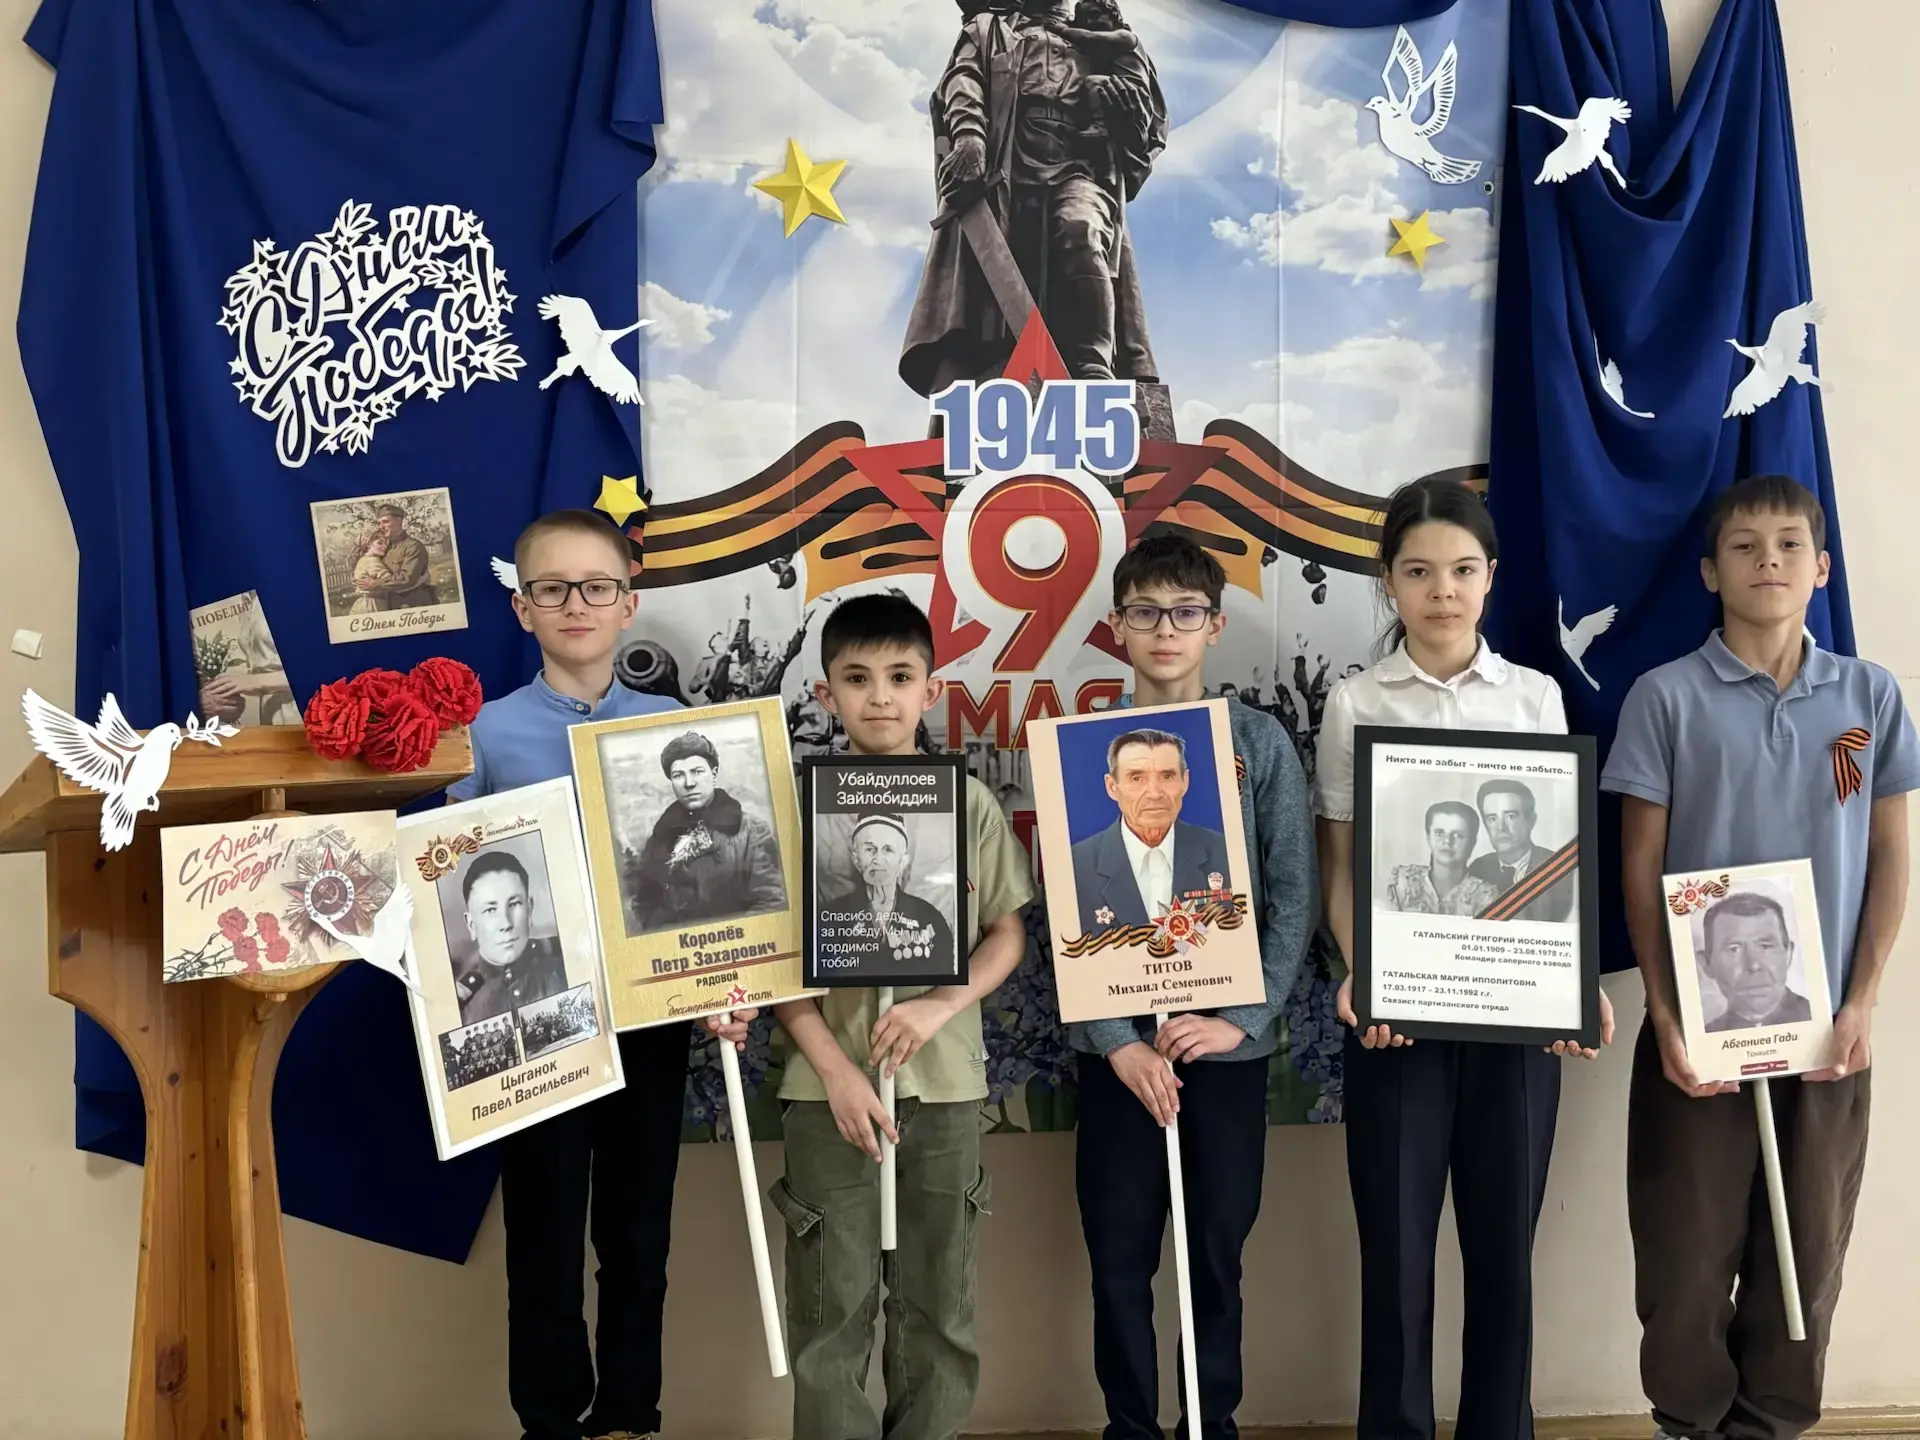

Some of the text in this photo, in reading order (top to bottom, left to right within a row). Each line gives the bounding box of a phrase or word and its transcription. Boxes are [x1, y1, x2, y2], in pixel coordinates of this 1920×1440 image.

[933, 382, 1137, 473] 1945
[967, 473, 1103, 674] 9
[350, 611, 447, 633] С Днем Победы
[1385, 754, 1417, 765] Никто
[1419, 757, 1433, 766] не
[1435, 756, 1467, 768] забыт
[1477, 761, 1507, 771] ничто
[1510, 764, 1523, 772] не
[1526, 764, 1573, 776] забыто...
[837, 771, 937, 789] Убайдуллоев
[836, 790, 938, 807] Зайлобиддин
[178, 822, 279, 886] С Днём
[185, 839, 295, 910] Победы!
[820, 908, 874, 922] Спасибо
[678, 925, 745, 950] Королёв
[820, 928, 835, 938] за
[1413, 930, 1572, 948] ГАТАЛЬСКИЙ ГРИГОРИЙ ИОСИФОВИЧ
[820, 941, 880, 955] гордимся
[651, 941, 777, 975] Петр Захарович
[820, 956, 860, 969] тобой!
[1454, 953, 1572, 968] Командир саперного взвода
[1142, 959, 1194, 976] ТИТОВ
[695, 970, 739, 988] РЯДОВОЙ
[1107, 975, 1233, 996] Михаил Семенович
[1382, 970, 1537, 987] ГАТАЛЬСКАЯ МАРИЯ ИППОЛИТОВНА
[1382, 983, 1427, 993] 17.03.1917
[1434, 986, 1479, 997] 23.11.1992
[1150, 993, 1194, 1008] рядовой
[1382, 996, 1510, 1012] Связист партизанского отряда
[1721, 1031, 1798, 1050] Абганиев Гади
[501, 1060, 558, 1091] Цыганок
[471, 1065, 590, 1121] Павел Васильевич
